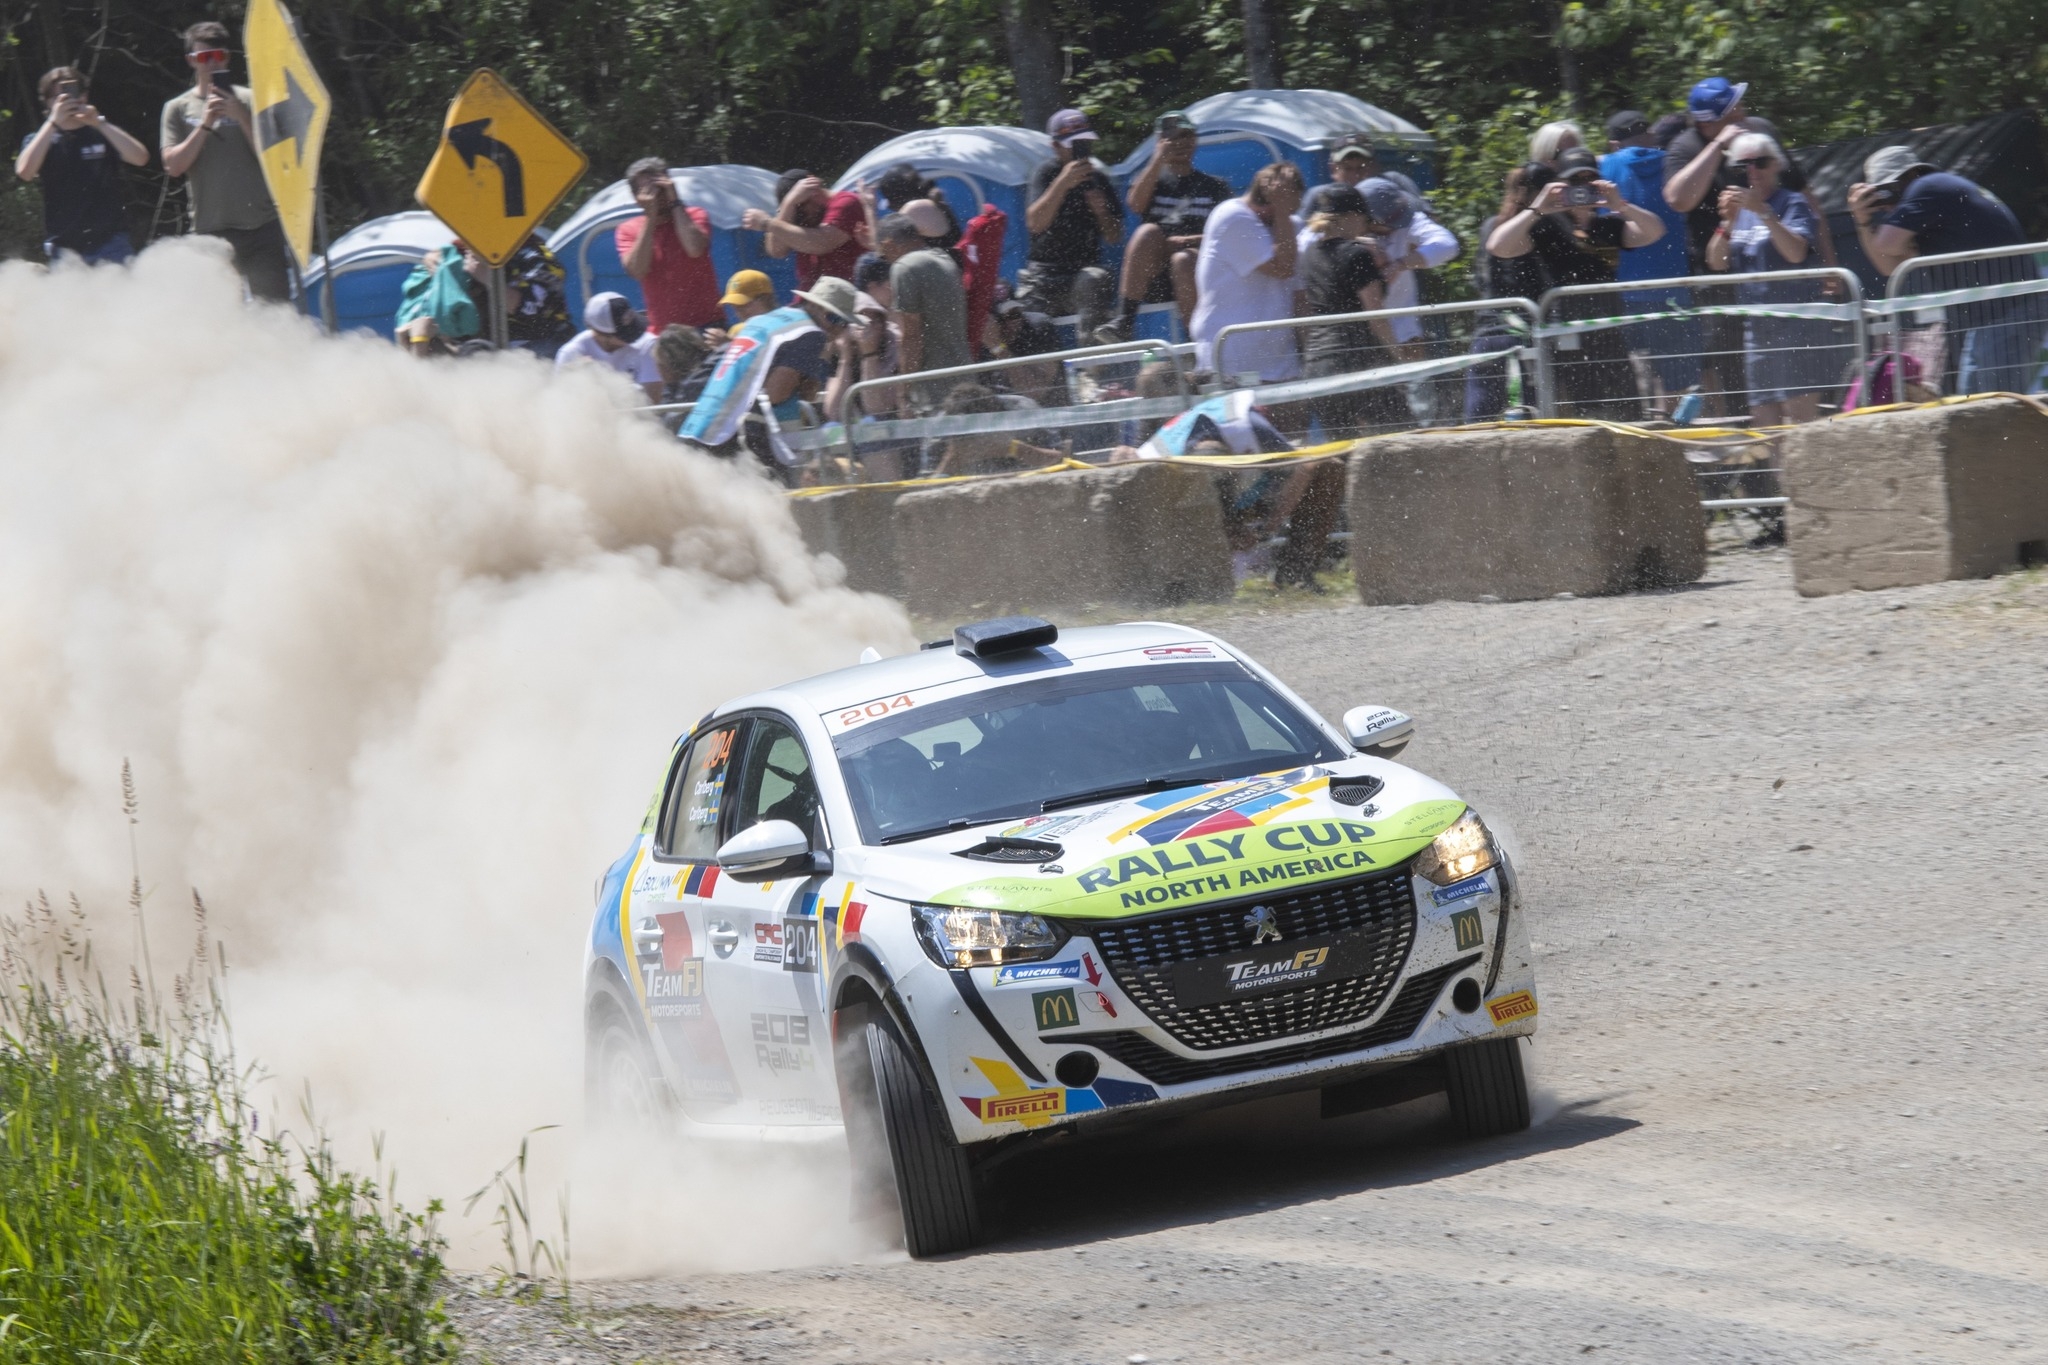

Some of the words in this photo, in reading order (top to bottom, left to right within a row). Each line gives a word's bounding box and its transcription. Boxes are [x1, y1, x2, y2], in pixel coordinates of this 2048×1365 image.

[840, 695, 914, 726] 204
[1366, 710, 1391, 721] 208
[703, 729, 736, 769] 204
[1404, 803, 1457, 825] STELLANTIS
[1076, 833, 1245, 893] RALLY
[1265, 822, 1376, 850] CUP
[966, 885, 1053, 893] STELLANTIS
[1120, 874, 1231, 908] NORTH
[1240, 850, 1376, 887] AMERICA
[1447, 882, 1488, 900] MICHELIN
[785, 924, 817, 966] 204
[1015, 966, 1079, 978] MICHELIN
[1235, 969, 1317, 990] MOTORSPORTS
[651, 1004, 701, 1017] MOTORSPORTS
[1490, 994, 1535, 1021] PIRELLI
[751, 1013, 810, 1045] 208
[987, 1092, 1059, 1118] PIRELLI
